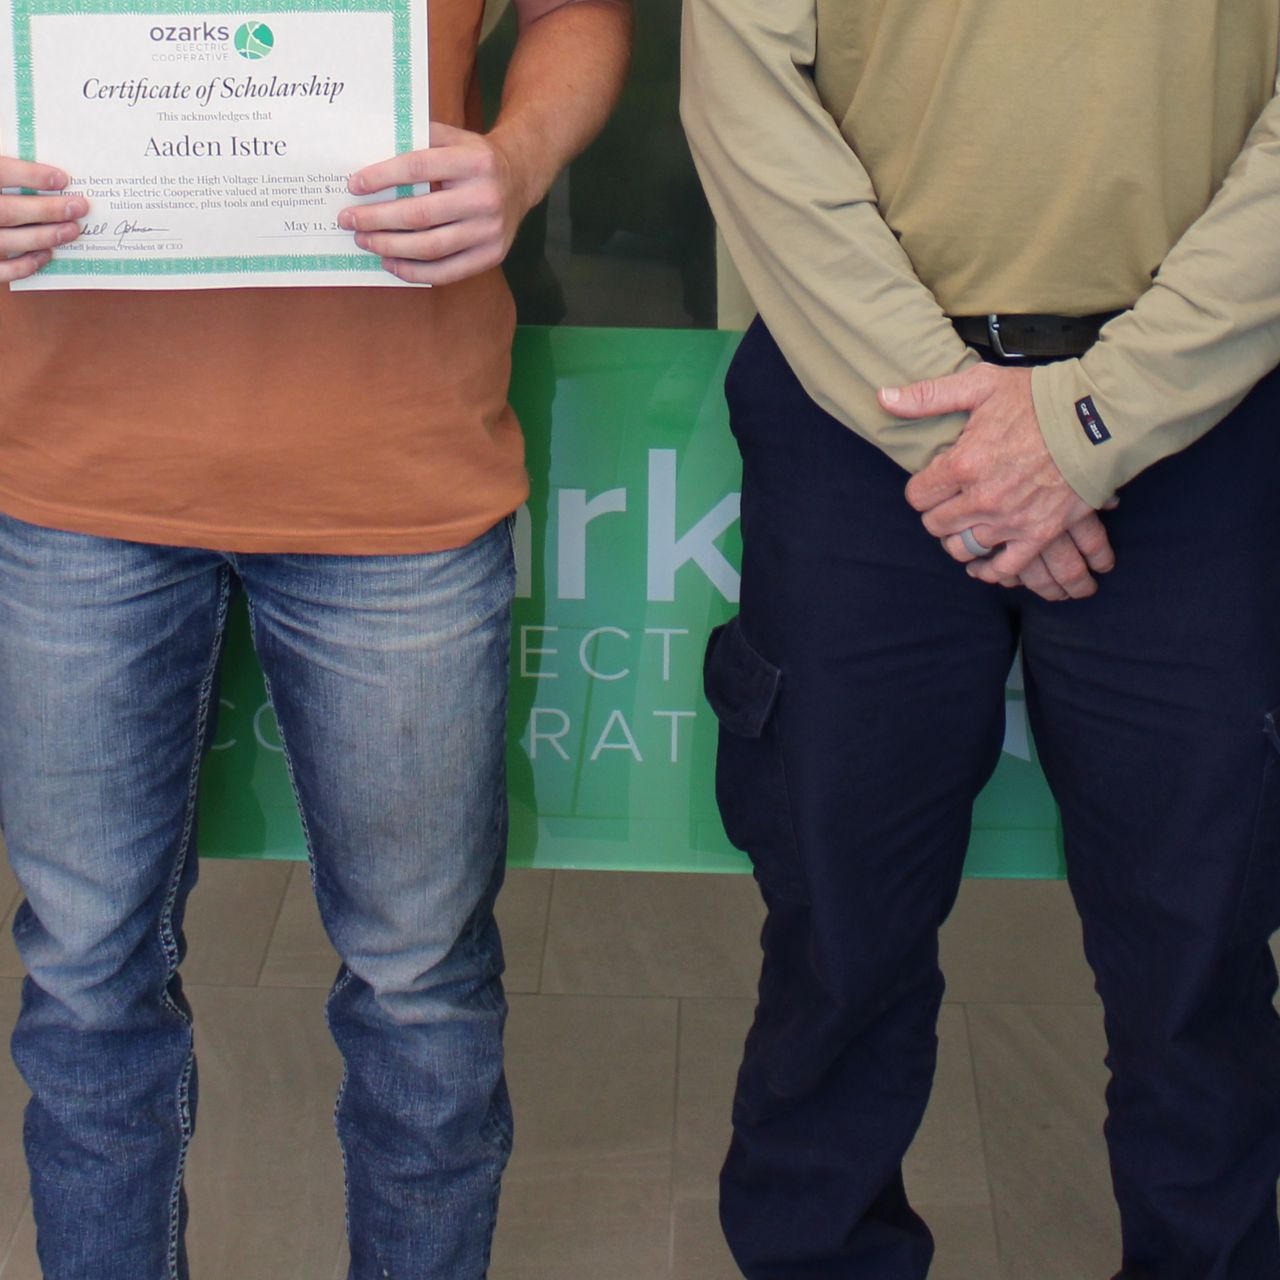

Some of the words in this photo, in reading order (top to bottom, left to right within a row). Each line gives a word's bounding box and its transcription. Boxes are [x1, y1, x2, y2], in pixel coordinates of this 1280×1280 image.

[150, 21, 229, 41] ozarks
[175, 43, 229, 52] ELECTRIC
[152, 54, 229, 62] COOPERATIVE
[83, 77, 191, 107] Certificate
[195, 77, 220, 107] of
[220, 74, 344, 104] Scholarship
[157, 112, 179, 121] This
[181, 111, 250, 122] acknowledges
[252, 111, 272, 120] that
[144, 135, 223, 156] Aaden
[231, 136, 287, 156] Istre
[70, 176, 86, 185] has
[89, 176, 113, 185] been
[115, 175, 158, 185] awarded
[160, 175, 176, 185] the
[178, 175, 195, 184] the
[197, 175, 220, 186] High
[222, 175, 258, 185] Voltage
[261, 174, 304, 184] Lineman
[86, 188, 120, 198] Ozarks
[123, 188, 160, 198] Electric
[163, 187, 222, 200] Cooperative
[225, 186, 256, 196] valued
[259, 187, 269, 195] at
[300, 186, 322, 195] than
[110, 200, 143, 210] tuition
[145, 200, 198, 210] assistance,
[200, 199, 222, 210] plus
[224, 199, 248, 208] tools
[250, 198, 268, 207] and
[271, 197, 327, 208] equipment.
[284, 221, 309, 233] May
